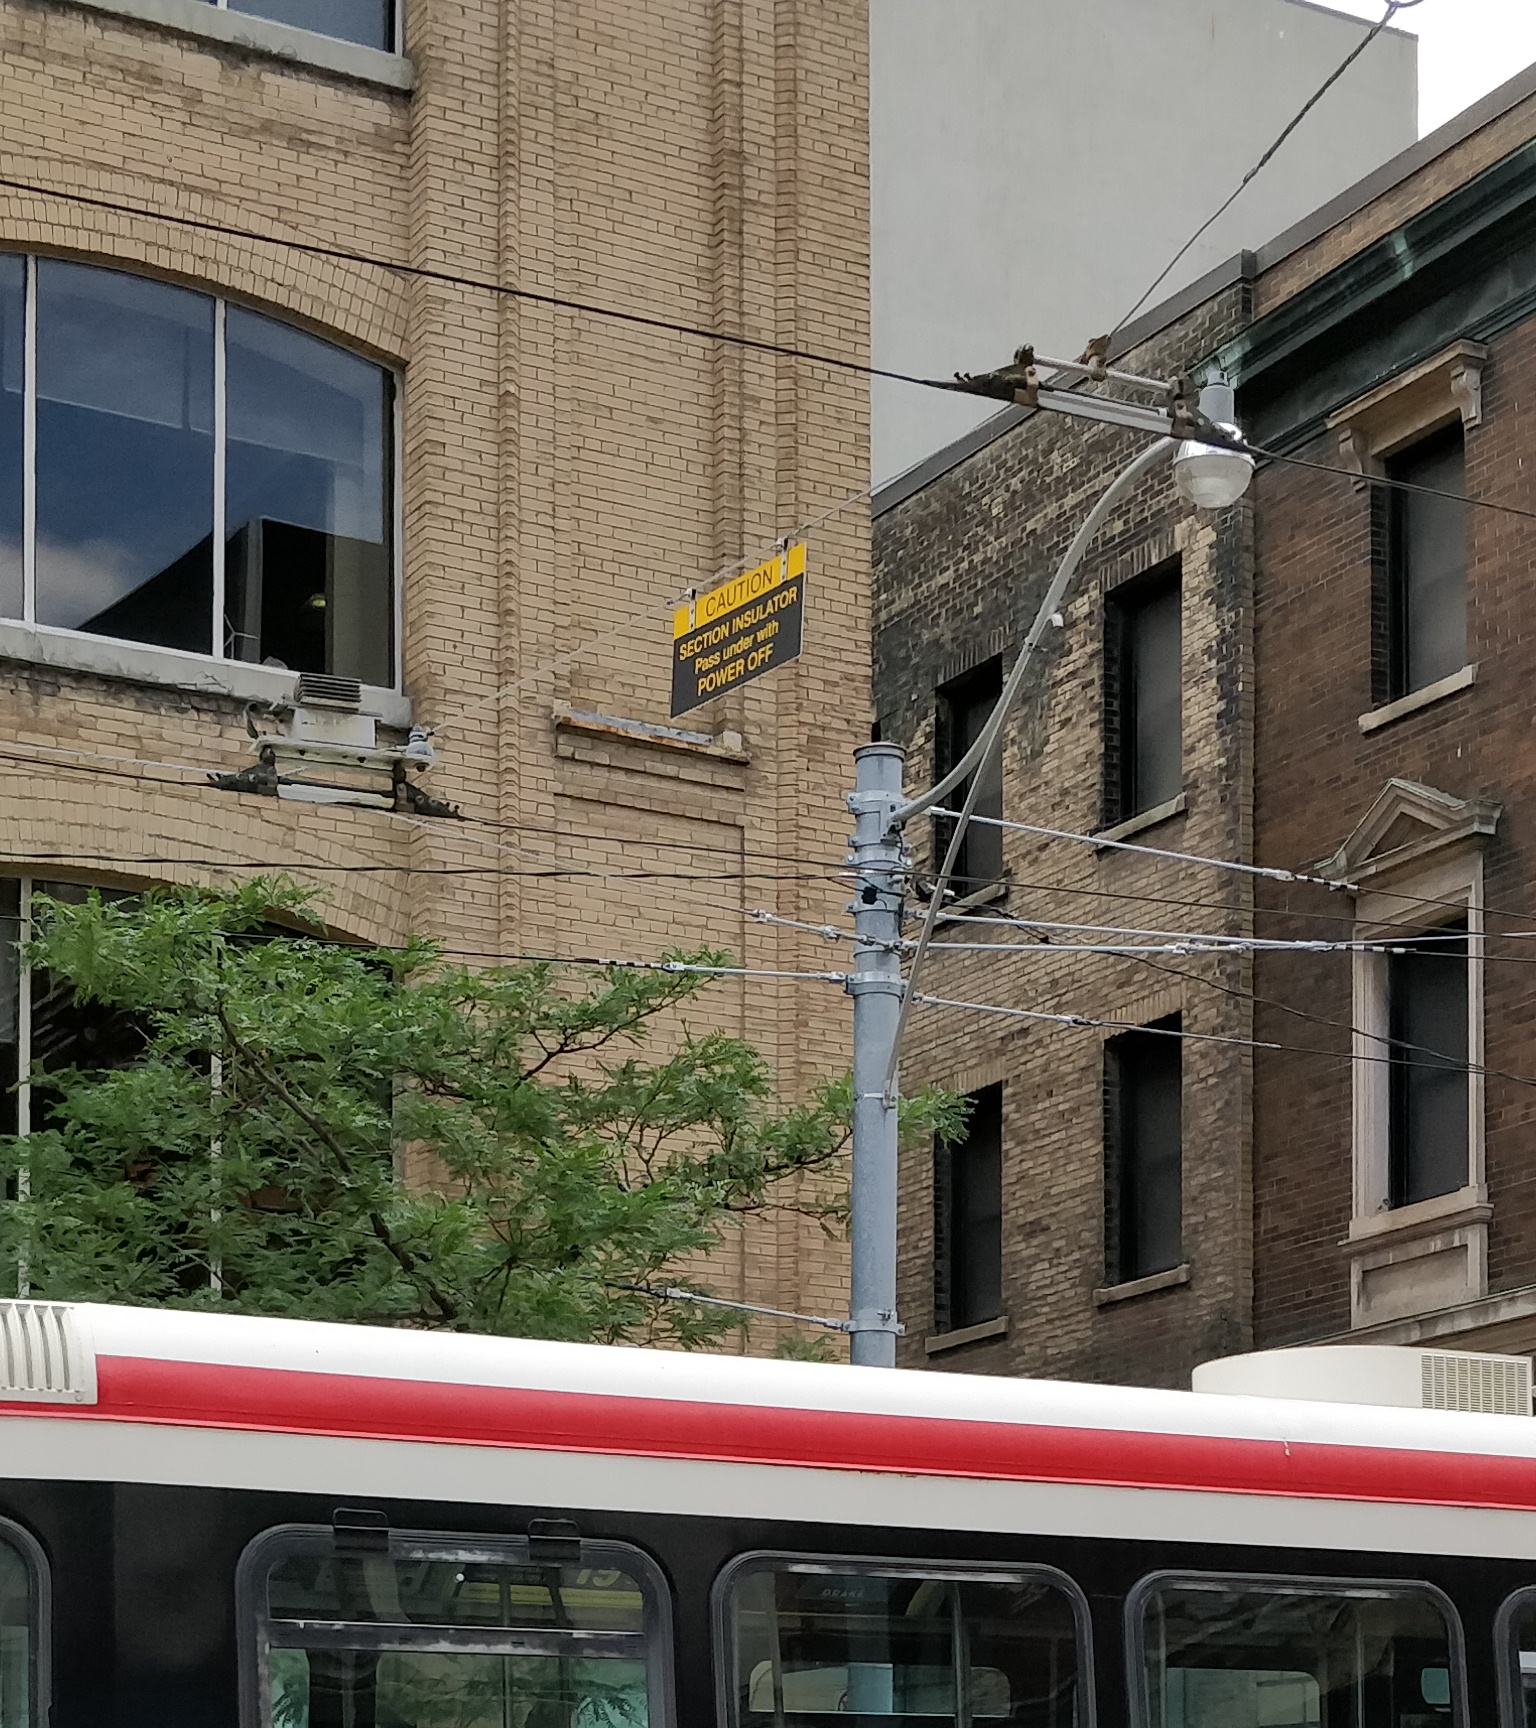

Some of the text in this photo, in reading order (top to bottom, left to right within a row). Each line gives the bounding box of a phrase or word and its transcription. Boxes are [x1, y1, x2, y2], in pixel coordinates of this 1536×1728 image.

[705, 565, 773, 617] CAUTION
[679, 586, 798, 661] SECTION INSULATOR
[694, 619, 779, 674] Pass under with
[697, 643, 775, 696] POWER OFF
